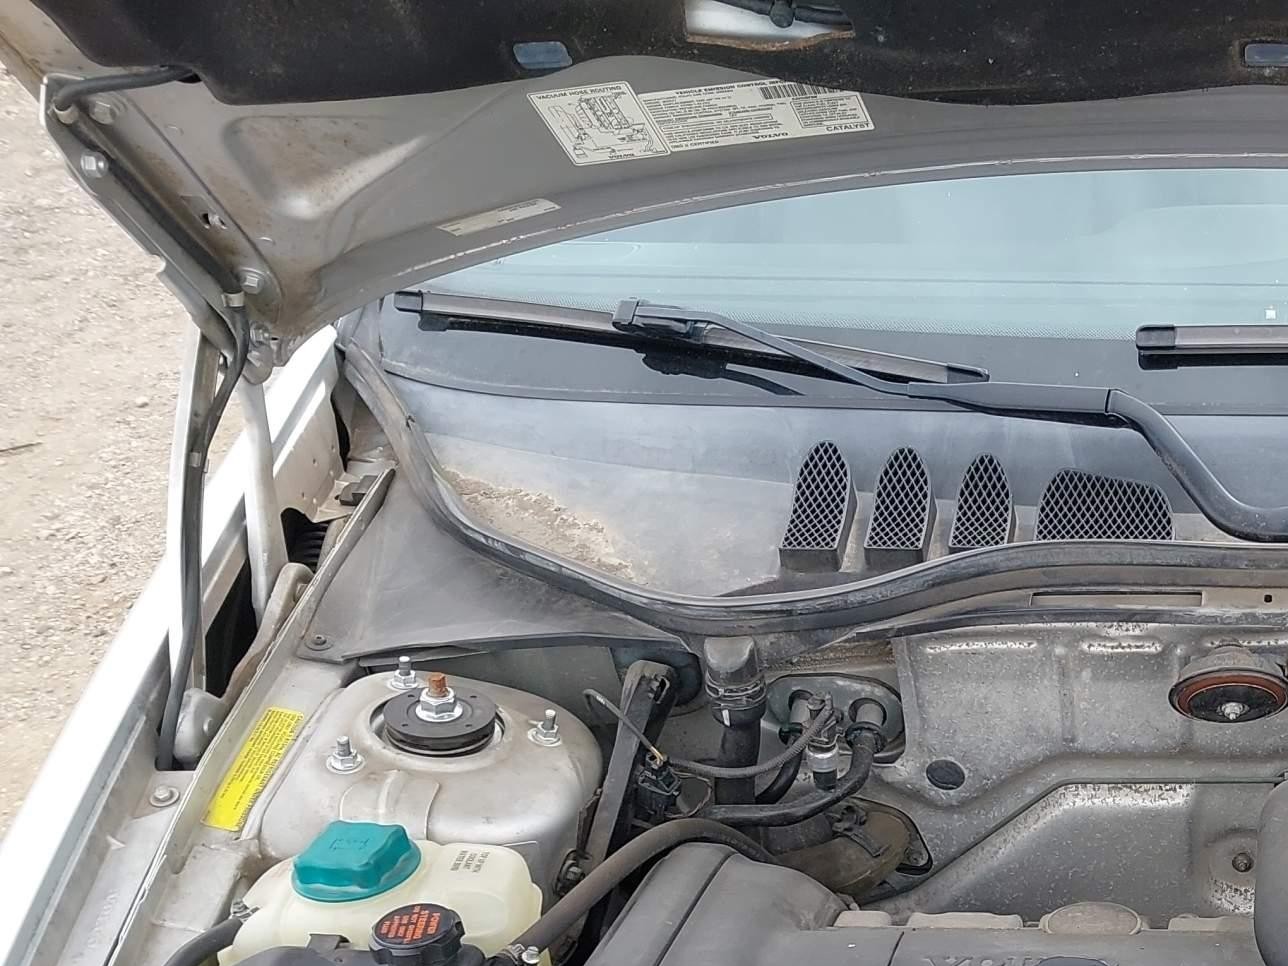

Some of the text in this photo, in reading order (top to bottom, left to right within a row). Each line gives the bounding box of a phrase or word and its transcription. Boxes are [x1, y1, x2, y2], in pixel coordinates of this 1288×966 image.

[536, 92, 568, 100] VACUUM
[589, 85, 622, 94] ROUTING
[826, 123, 870, 132] CATALYST
[752, 132, 788, 140] VOLVO
